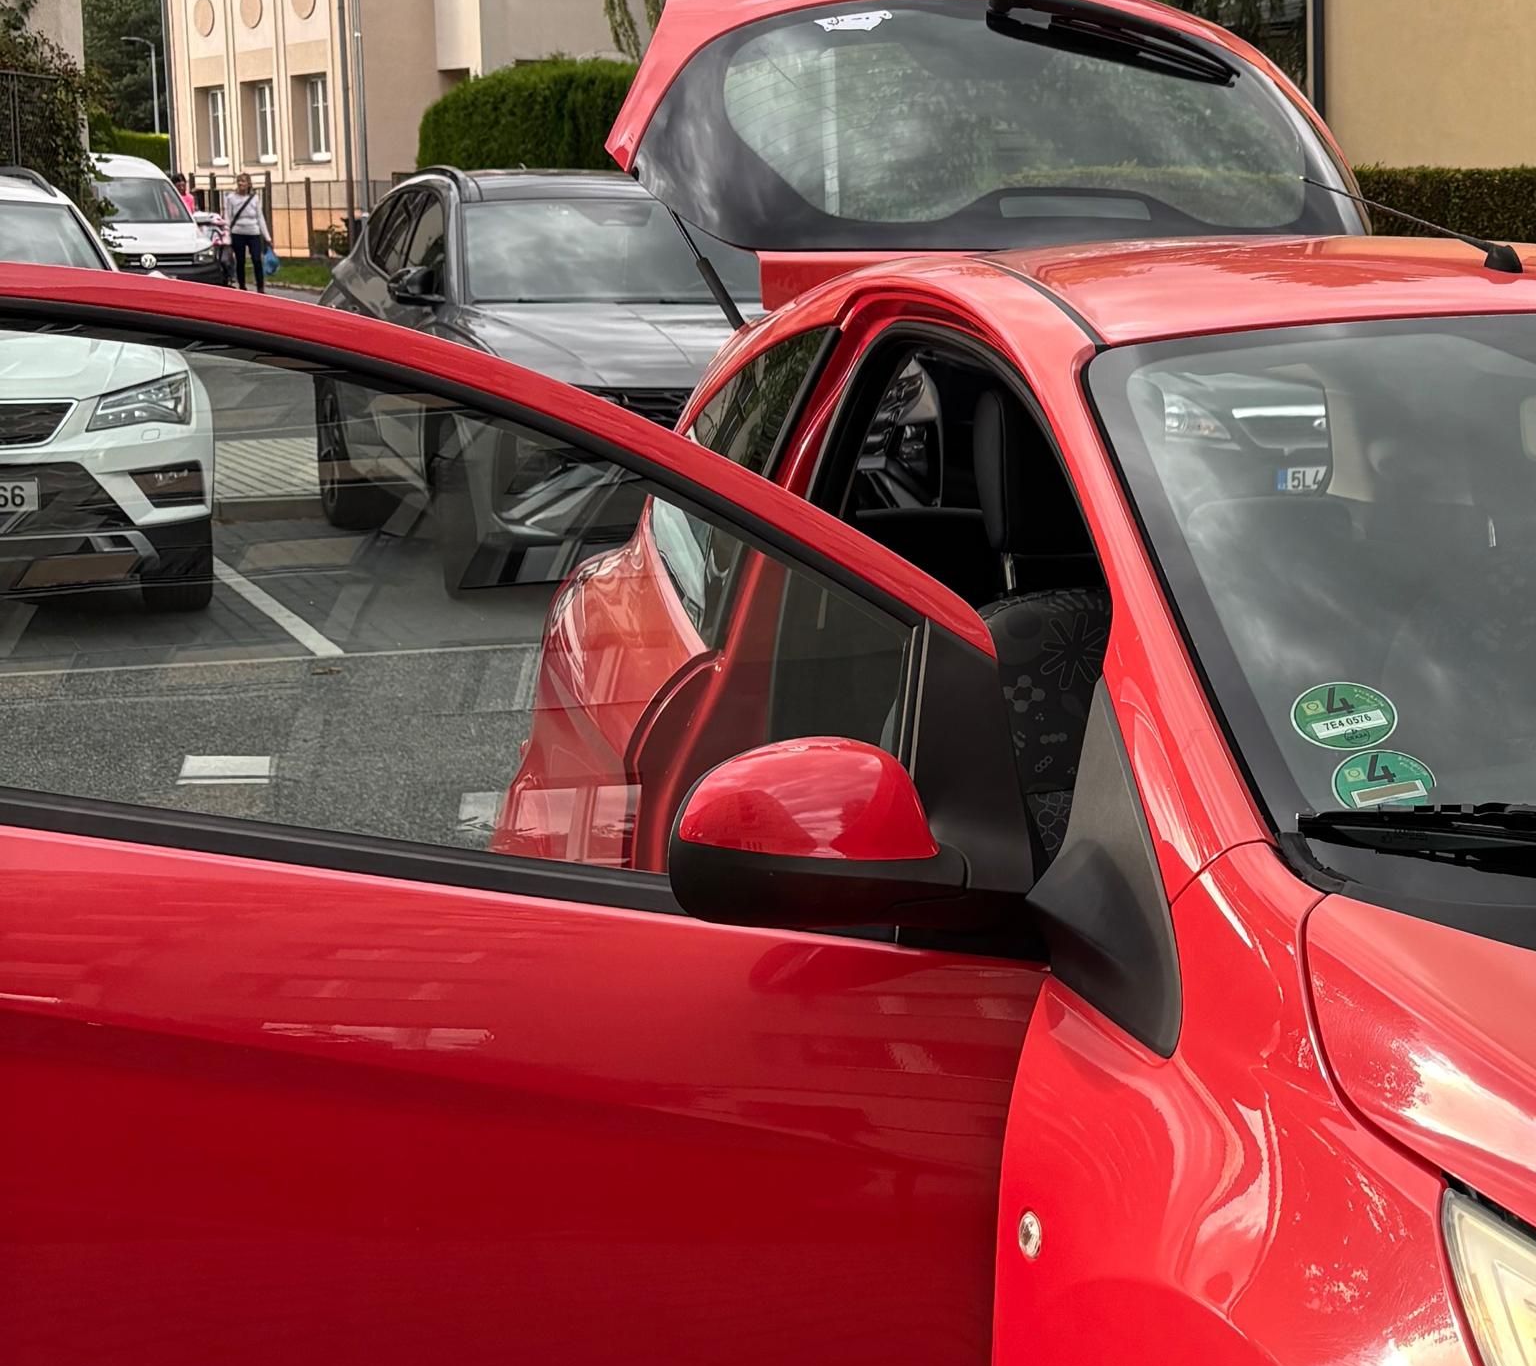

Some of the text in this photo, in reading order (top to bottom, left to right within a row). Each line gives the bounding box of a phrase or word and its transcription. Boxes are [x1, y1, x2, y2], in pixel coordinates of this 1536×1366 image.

[1326, 687, 1355, 714] 4
[1323, 714, 1372, 731] 7E4 0576
[1367, 754, 1396, 782] 4
